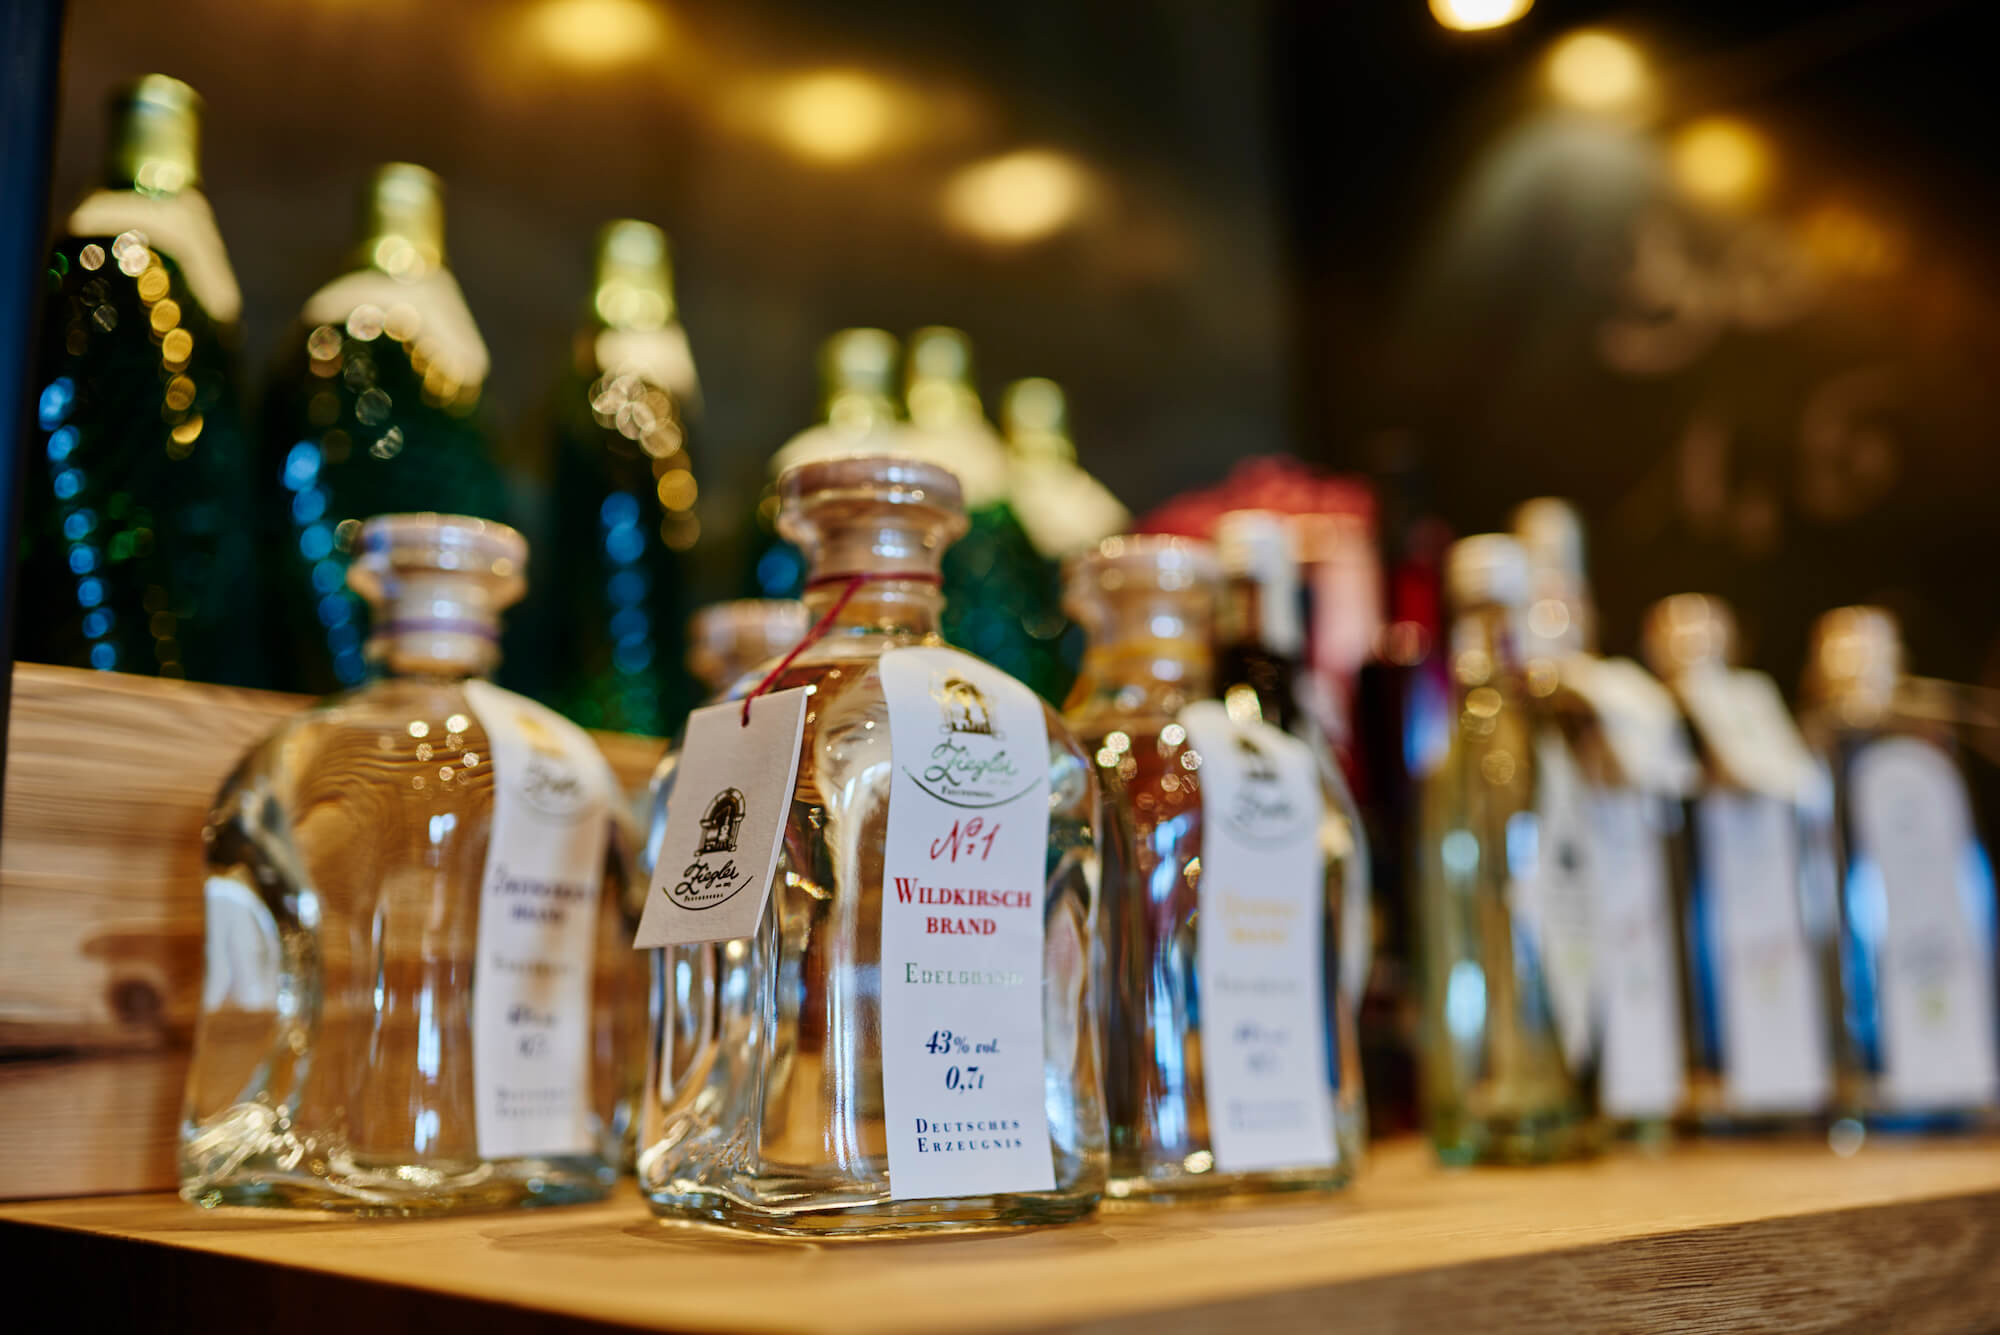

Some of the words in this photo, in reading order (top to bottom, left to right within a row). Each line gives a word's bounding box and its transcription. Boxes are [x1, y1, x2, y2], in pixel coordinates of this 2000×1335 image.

[894, 877, 1032, 908] WILDKIRSCH
[926, 916, 997, 936] BRAND
[904, 961, 1024, 985] EDELBR
[925, 1030, 970, 1055] 43%
[915, 1118, 1021, 1134] DEUTSCHES
[918, 1136, 1022, 1152] ERZEUGNIS
